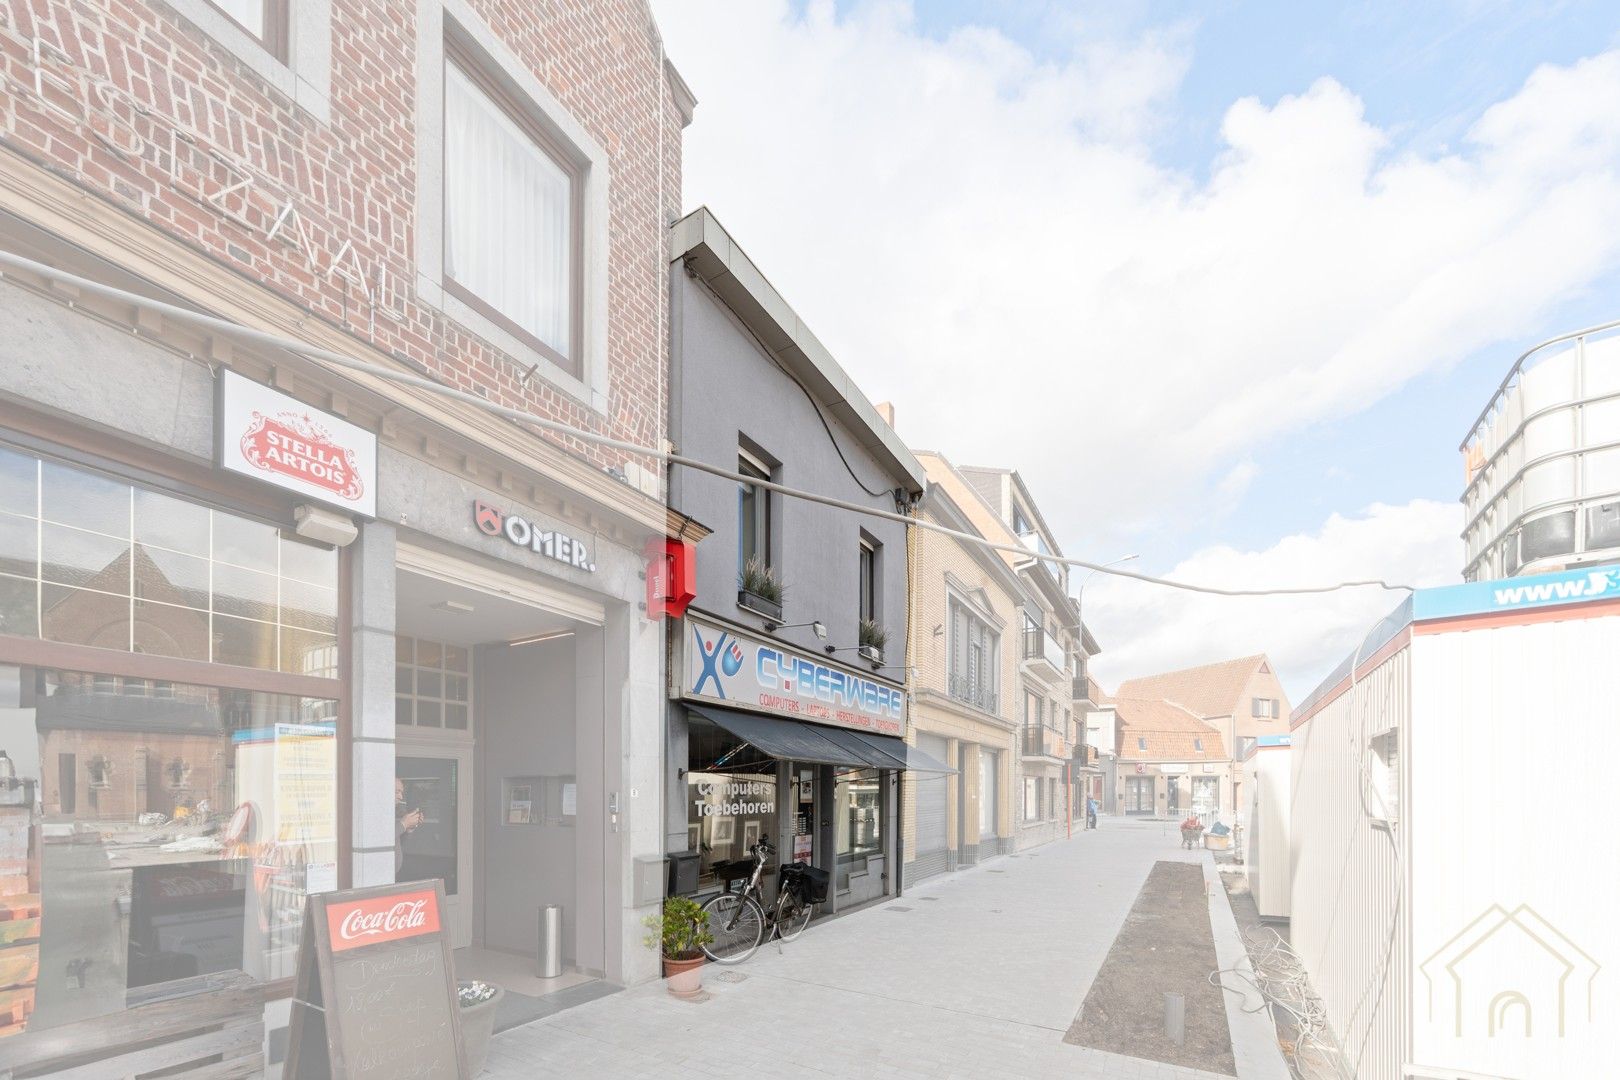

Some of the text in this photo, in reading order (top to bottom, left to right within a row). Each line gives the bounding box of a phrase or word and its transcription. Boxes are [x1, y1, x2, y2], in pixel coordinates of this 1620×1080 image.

[0, 32, 406, 322] ESTZAAL
[265, 446, 346, 485] ARTOIS
[266, 430, 344, 471] STELLA
[756, 645, 901, 719] CYBERWARE
[759, 693, 800, 712] COMPUTERS
[806, 703, 830, 719] LAPTOPS
[695, 799, 774, 816] Toebehoren
[697, 780, 772, 798] Computers
[340, 899, 428, 939] Coca-Cola
